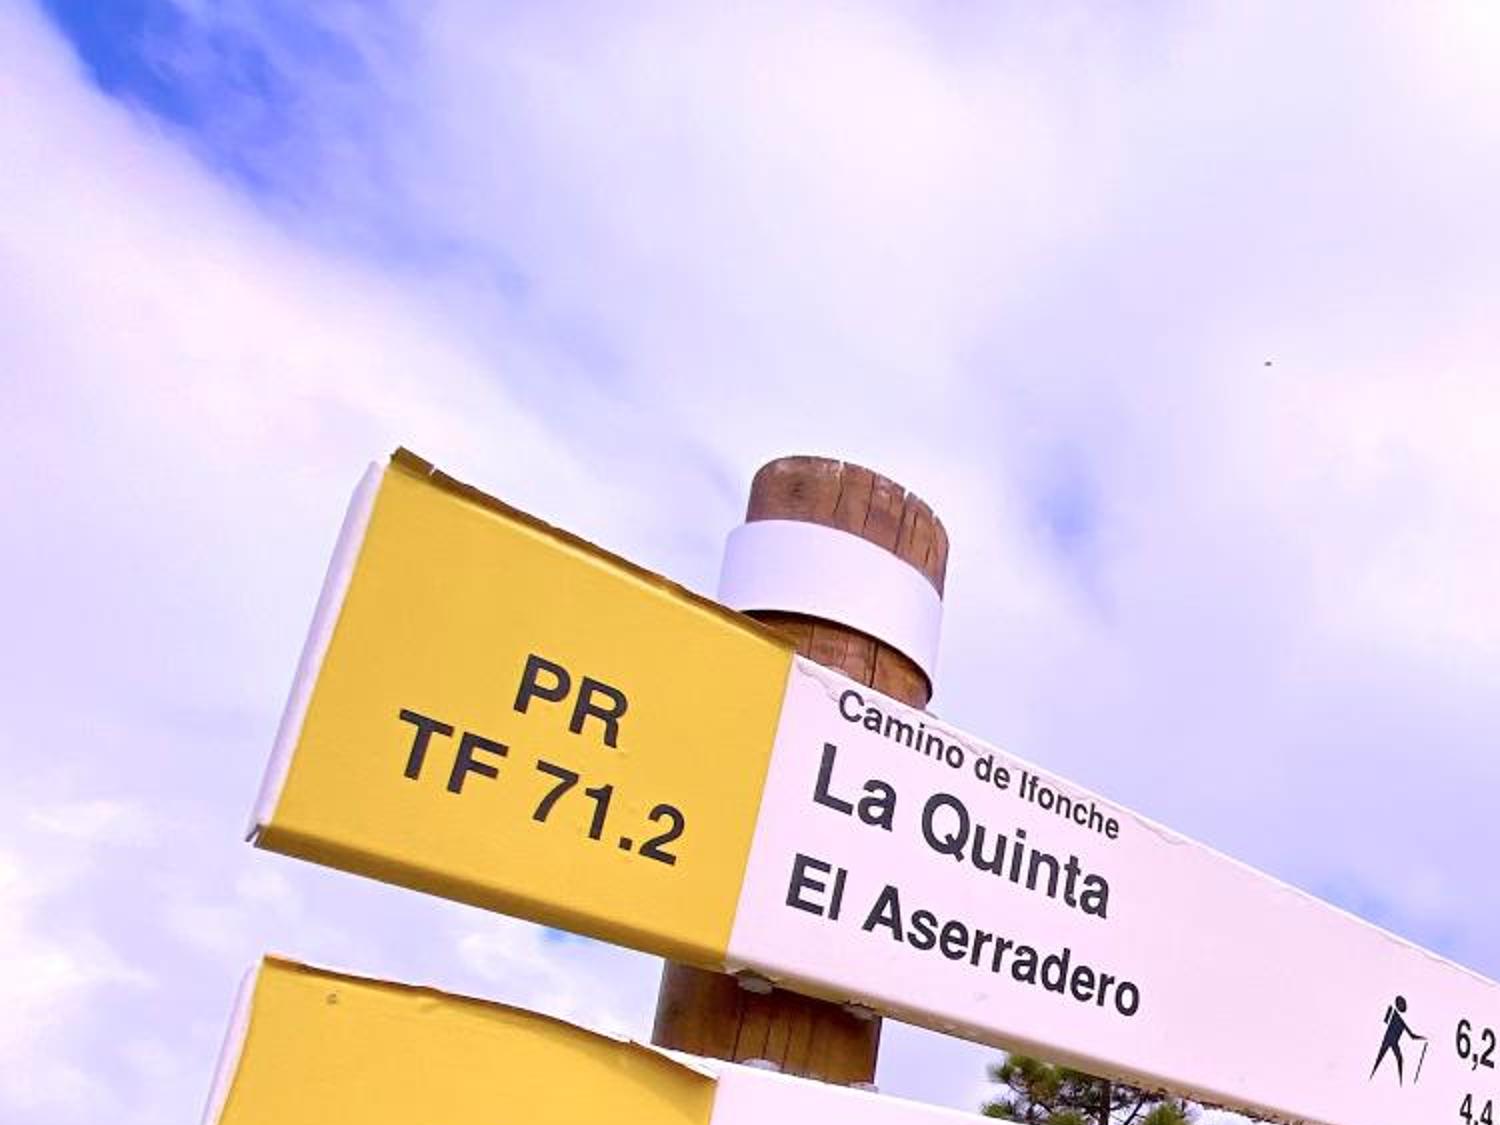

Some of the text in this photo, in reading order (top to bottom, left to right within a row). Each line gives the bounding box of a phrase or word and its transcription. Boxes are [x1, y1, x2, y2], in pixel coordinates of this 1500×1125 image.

[513, 653, 628, 749] PR
[840, 690, 1119, 840] Camino de Ifonche
[399, 708, 685, 867] TF 71.2
[813, 743, 1109, 919] La Quinta
[785, 853, 1140, 1017] El Aserradero
[1455, 1019, 1496, 1072] 6,2
